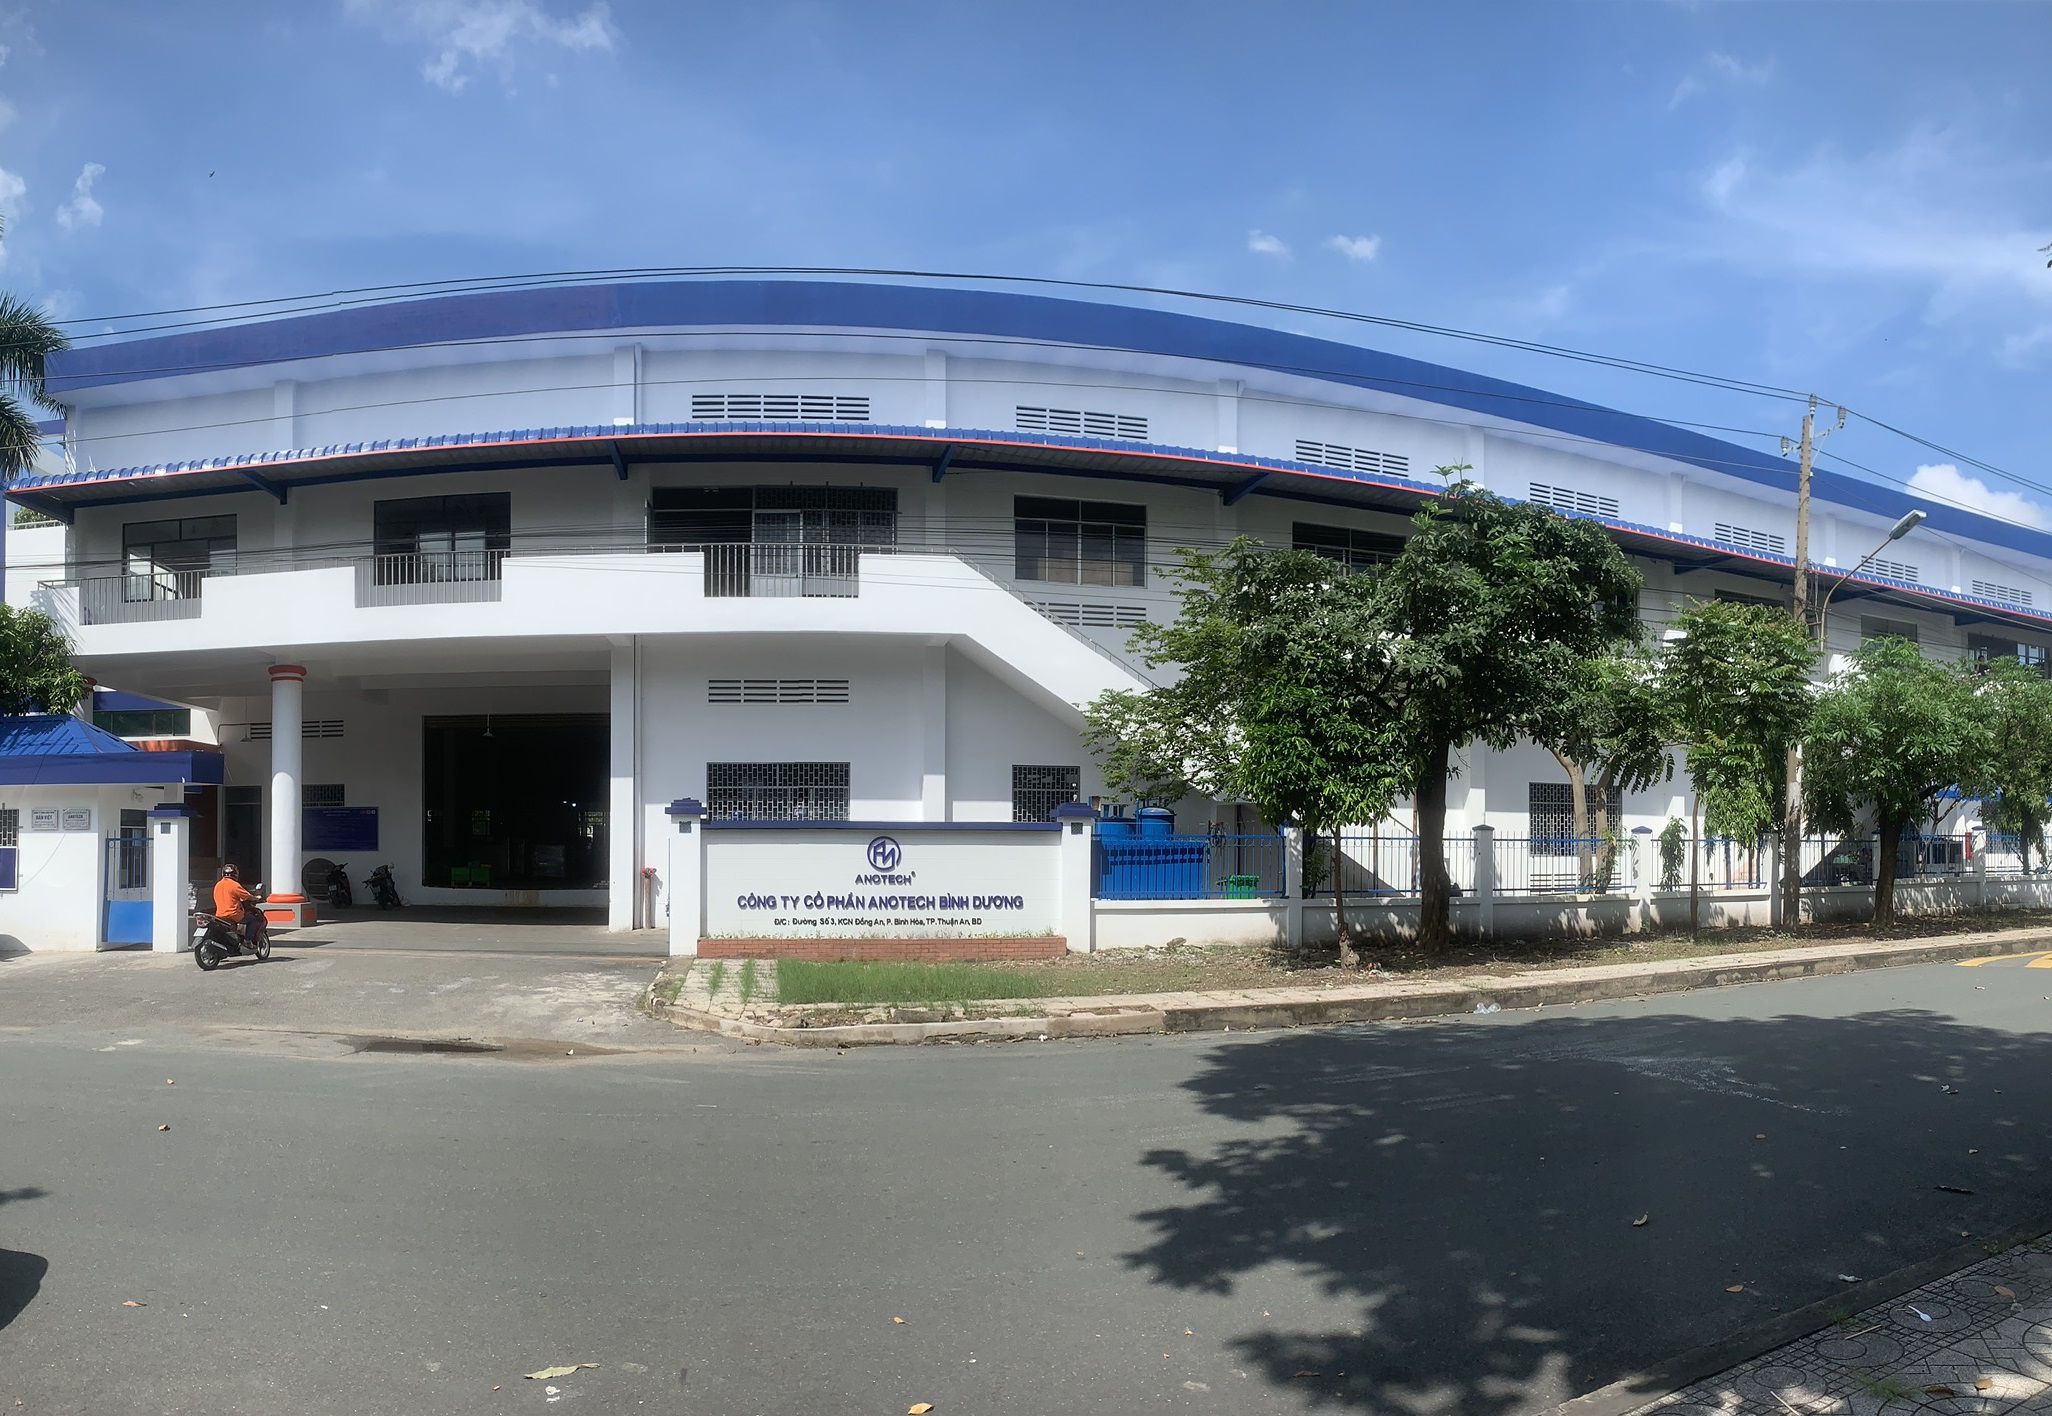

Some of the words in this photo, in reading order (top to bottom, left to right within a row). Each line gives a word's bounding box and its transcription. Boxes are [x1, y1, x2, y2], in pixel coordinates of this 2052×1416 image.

[855, 874, 912, 886] ANOTECH
[737, 892, 777, 910] CÔNG
[781, 896, 800, 910] TY
[867, 896, 936, 911] ANOTECH
[939, 893, 969, 911] BÌNH
[972, 895, 1024, 911] DƯƠNG
[838, 918, 853, 926] KCN
